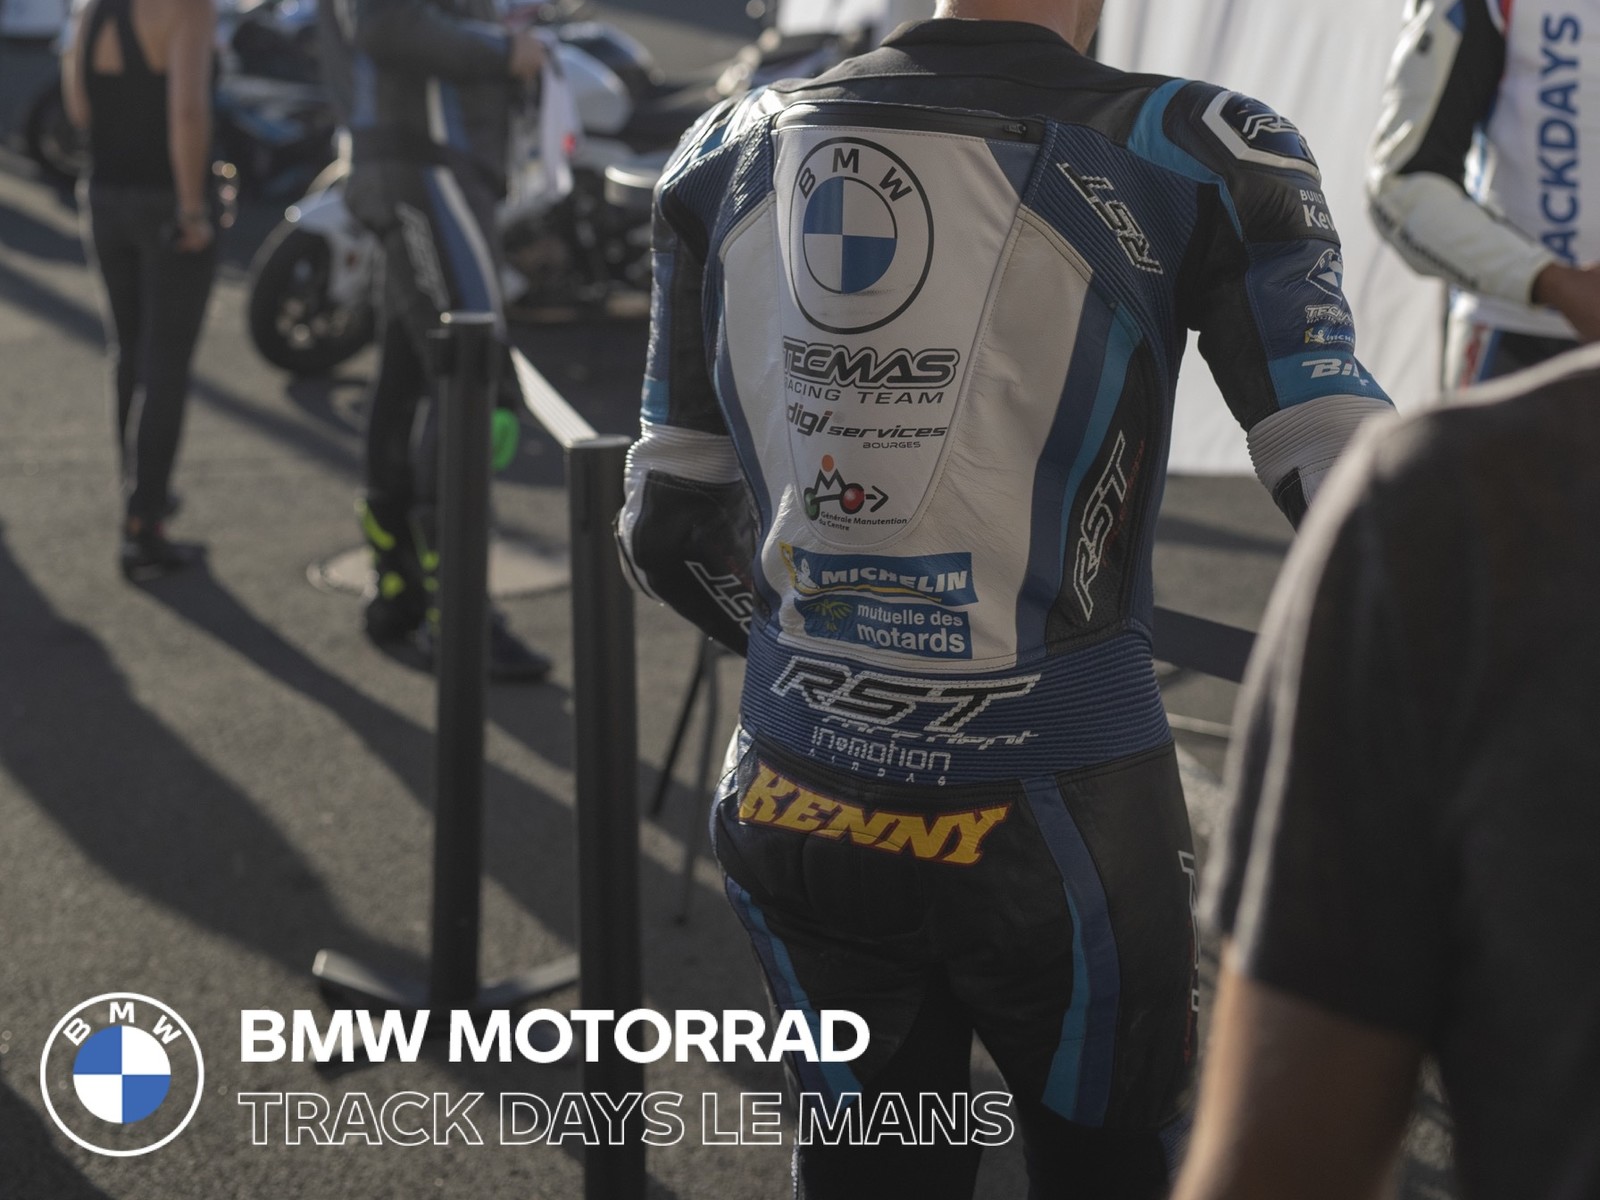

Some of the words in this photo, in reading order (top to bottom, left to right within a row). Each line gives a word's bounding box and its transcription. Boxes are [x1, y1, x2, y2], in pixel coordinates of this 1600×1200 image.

[798, 148, 912, 202] BMW
[857, 391, 944, 404] TEAM
[827, 425, 948, 438] services
[863, 441, 921, 449] BOURGES
[827, 520, 850, 531] Centre
[853, 517, 907, 525] Manutention
[822, 567, 968, 593] MICHELIN
[857, 604, 926, 626] mutuelle
[930, 611, 963, 626] des
[857, 623, 966, 653] motards
[771, 656, 1041, 732] RST
[738, 760, 1011, 865] KENNY
